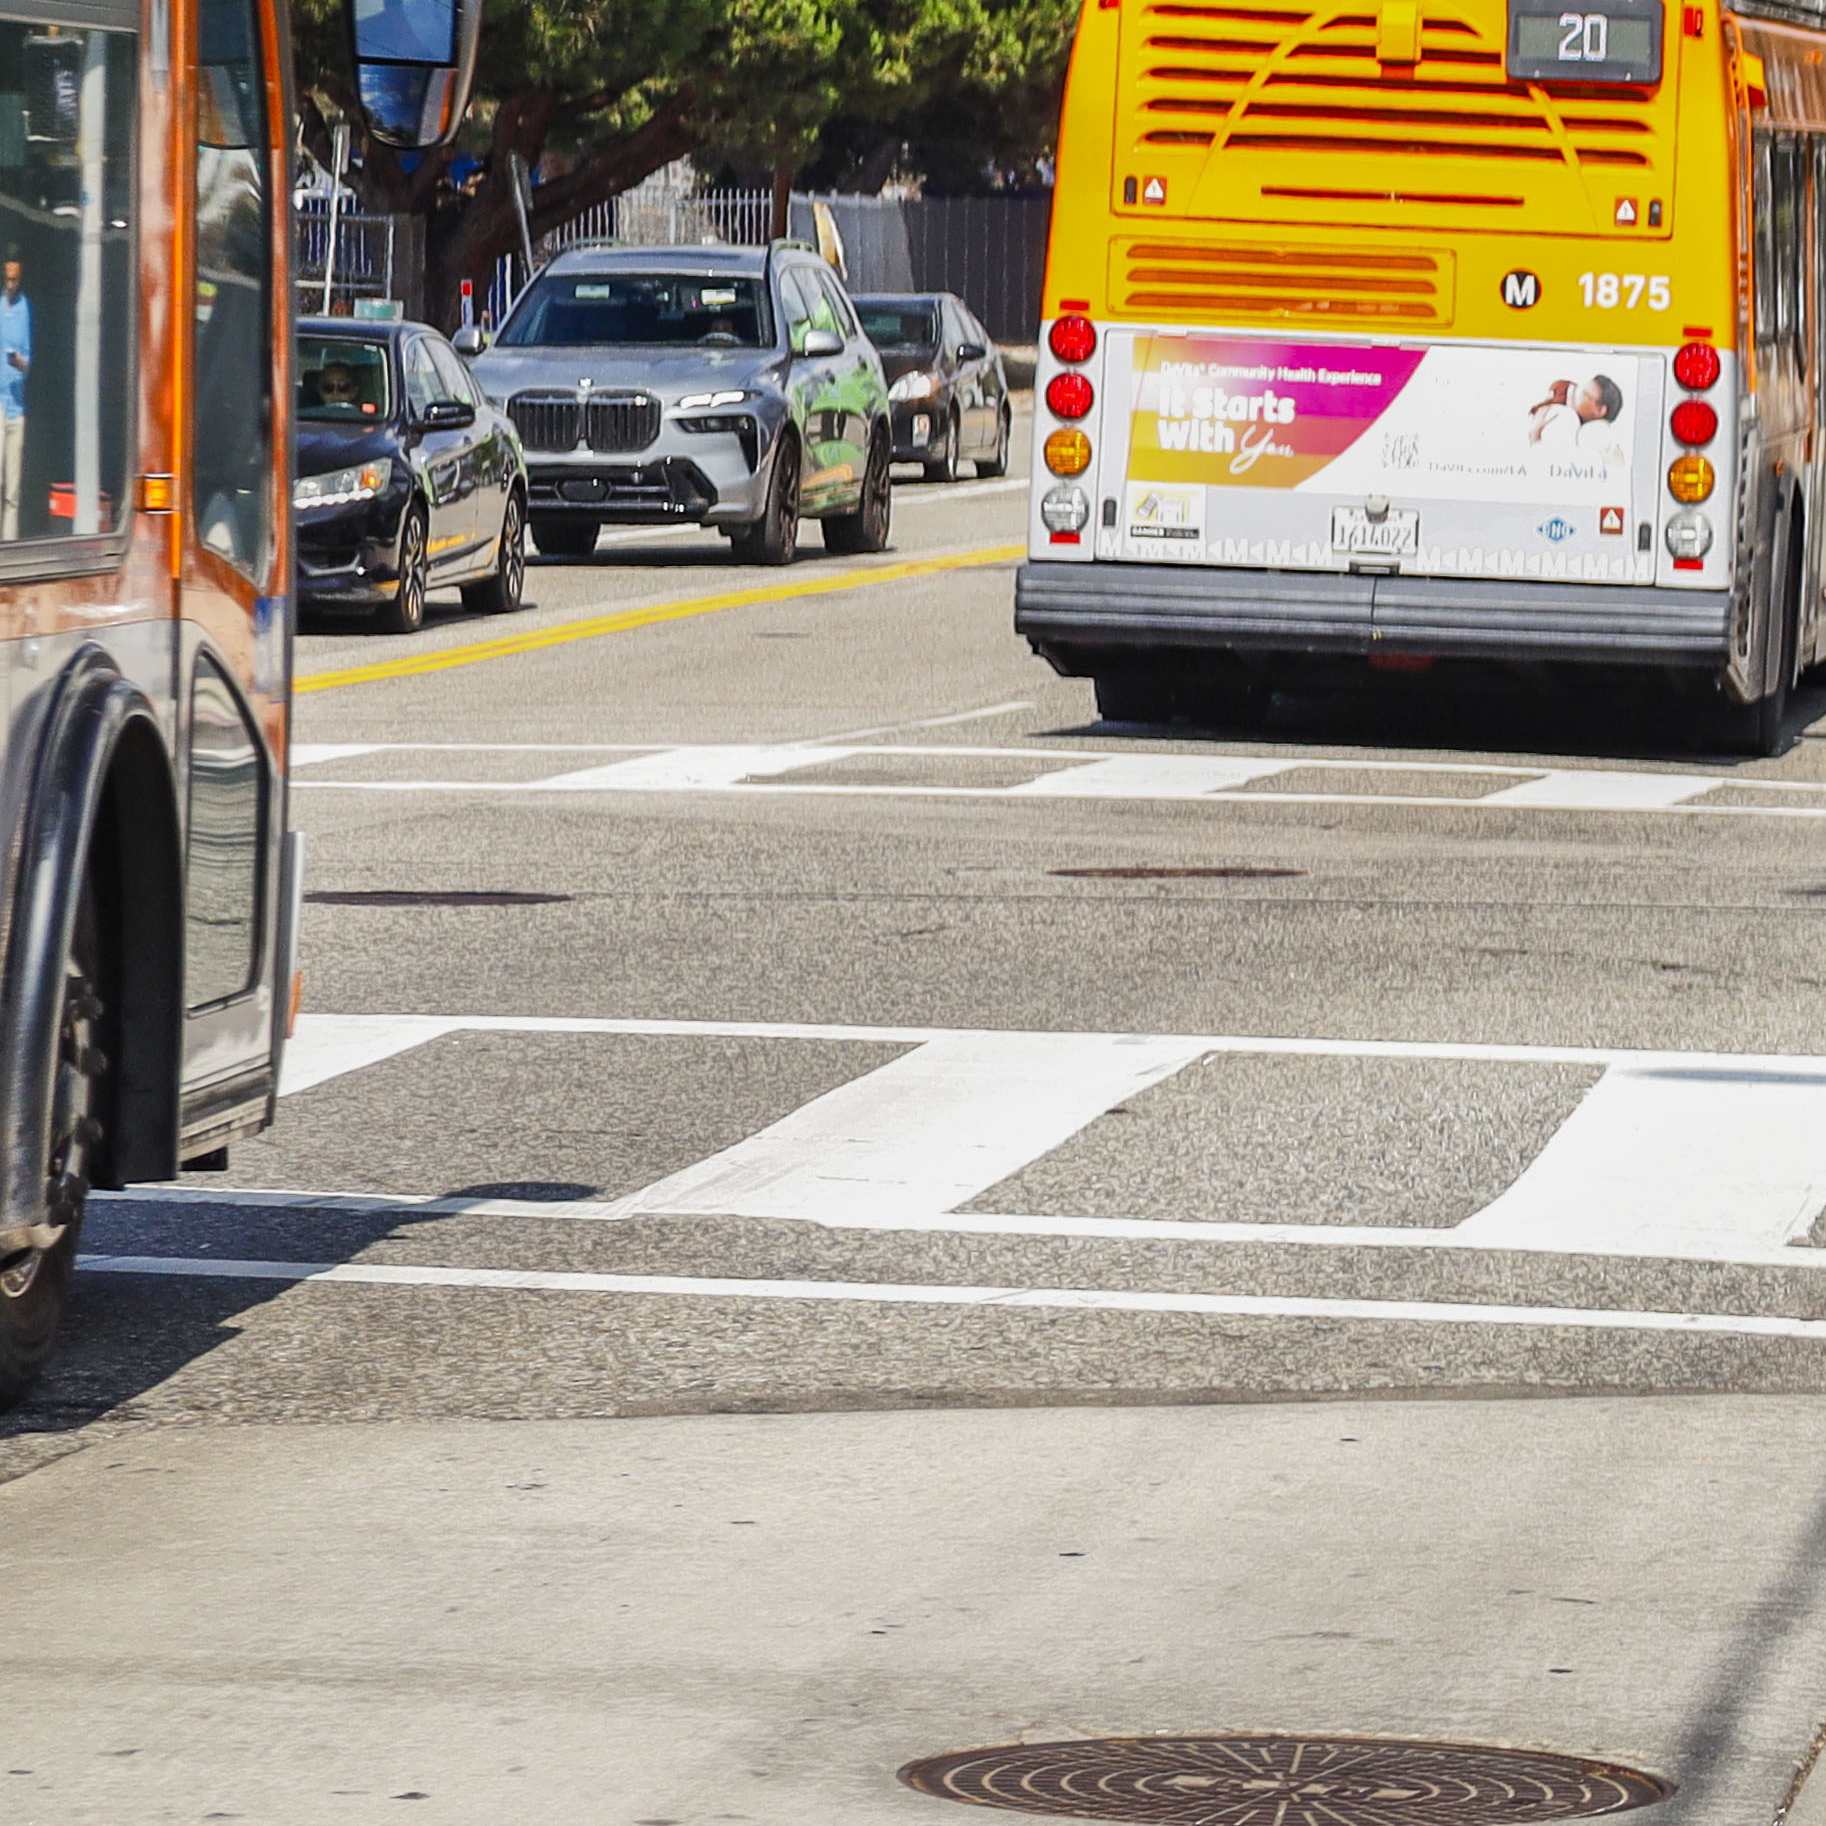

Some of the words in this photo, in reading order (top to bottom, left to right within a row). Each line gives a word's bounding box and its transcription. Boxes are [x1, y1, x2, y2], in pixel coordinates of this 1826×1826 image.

[1558, 12, 1607, 63] 20
[1505, 273, 1536, 306] M
[1578, 272, 1671, 311] 1875
[1159, 385, 1187, 419] It
[1192, 387, 1296, 425] Starts
